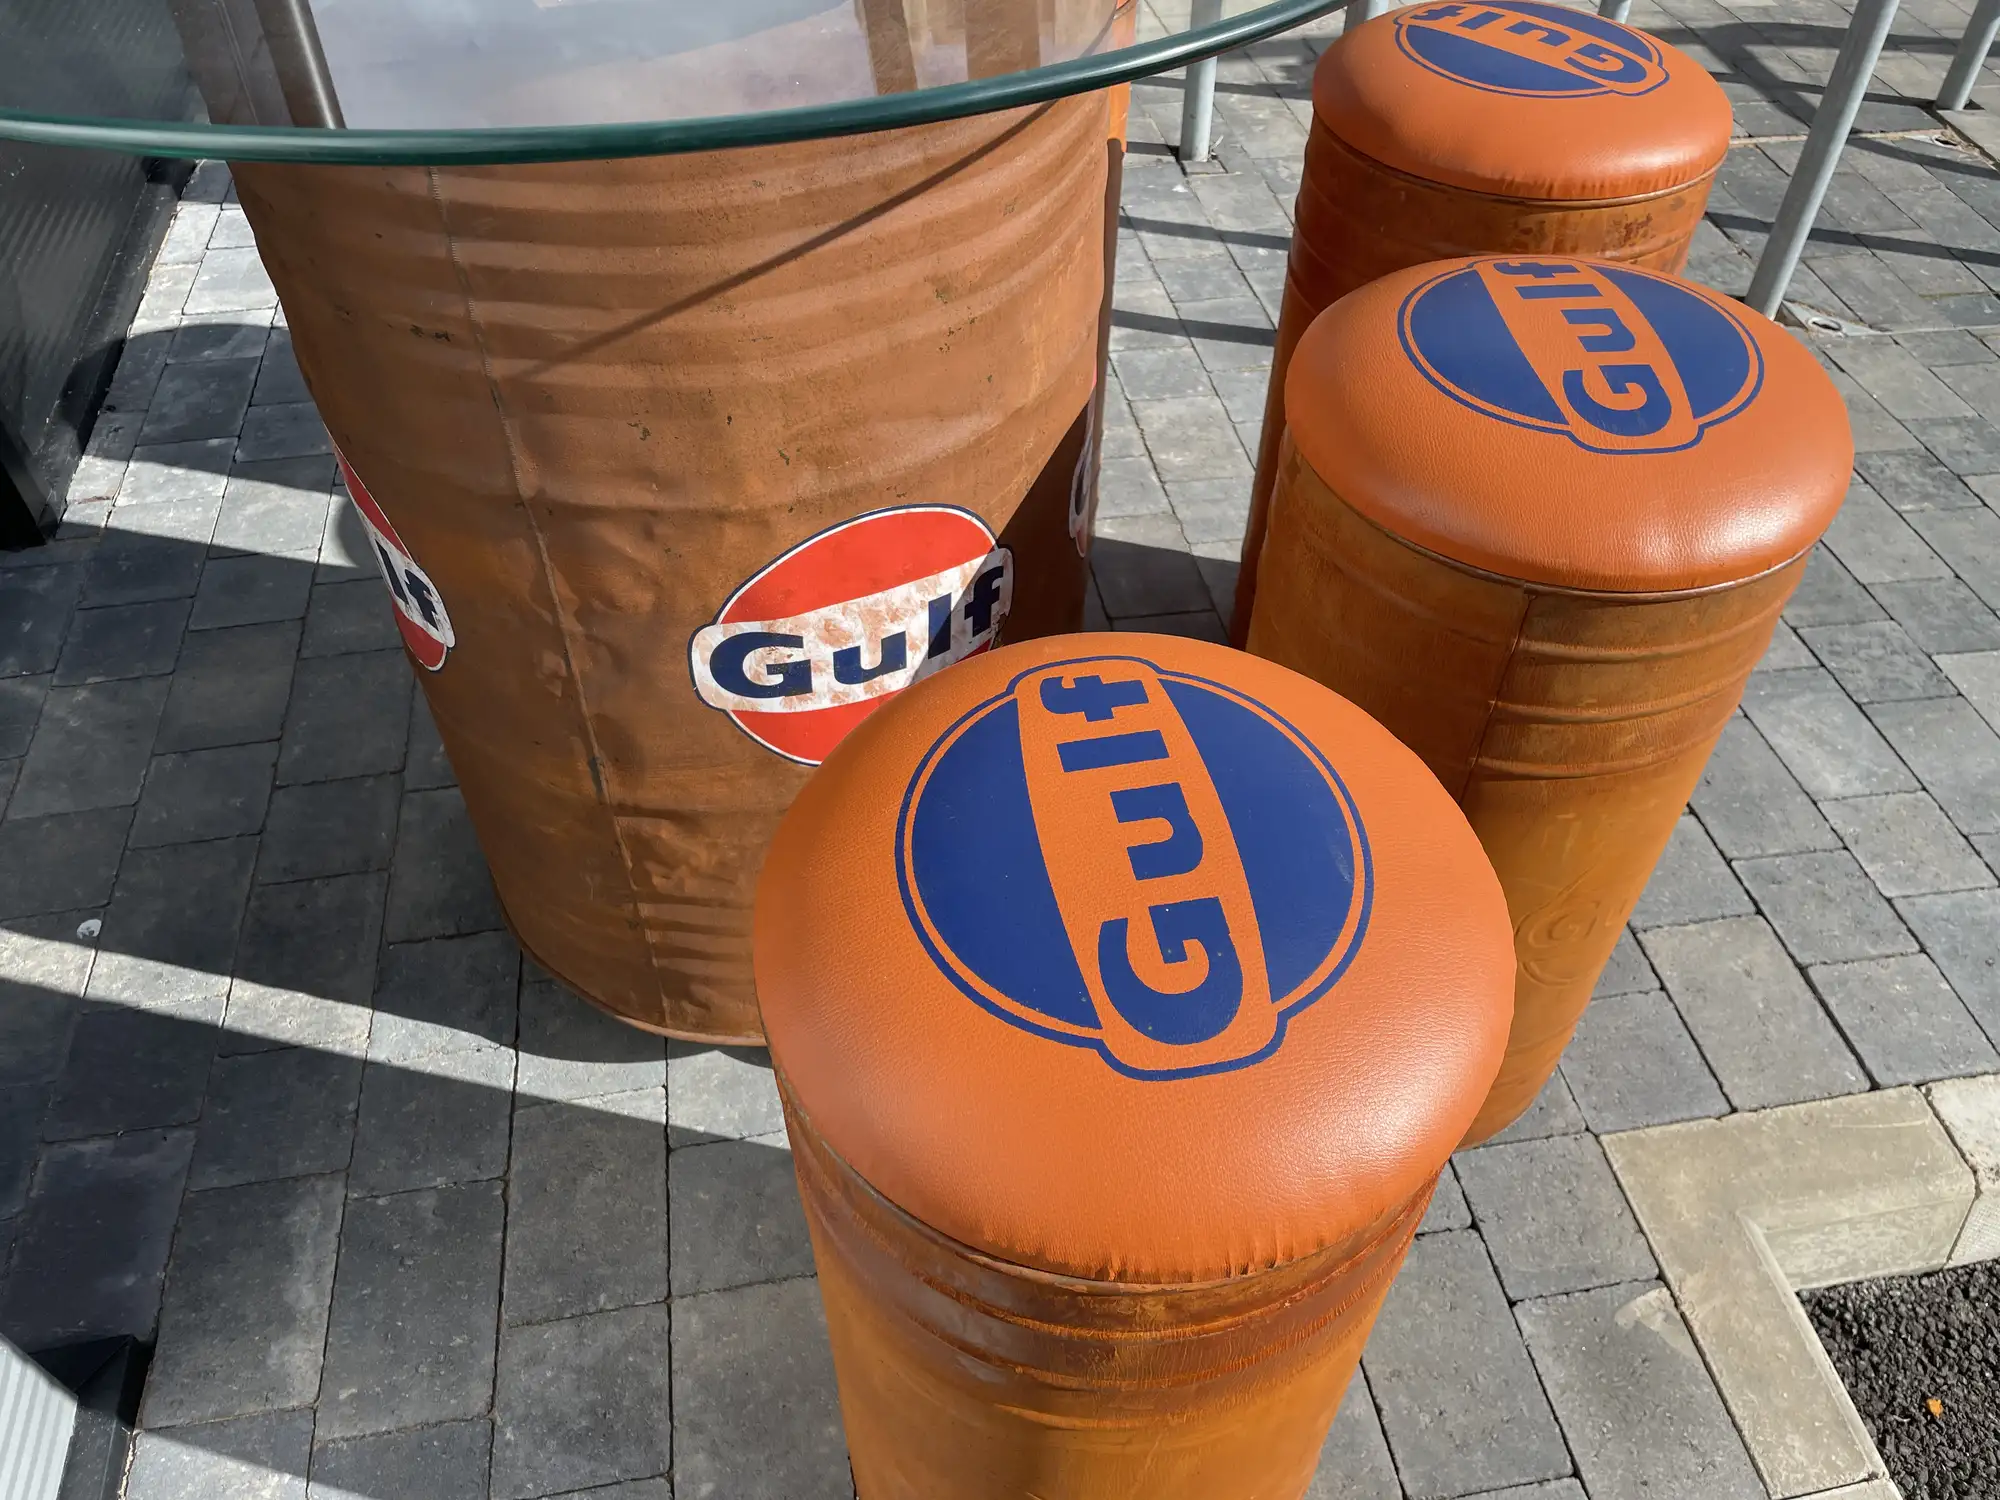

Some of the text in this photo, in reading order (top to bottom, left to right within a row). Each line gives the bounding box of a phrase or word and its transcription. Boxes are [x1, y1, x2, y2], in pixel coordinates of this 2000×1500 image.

[1409, 5, 1648, 84] Gulf
[1492, 261, 1673, 437] Gulf
[374, 538, 439, 632] lf
[708, 565, 1005, 699] Gulf
[1039, 674, 1244, 1046] Gulf
